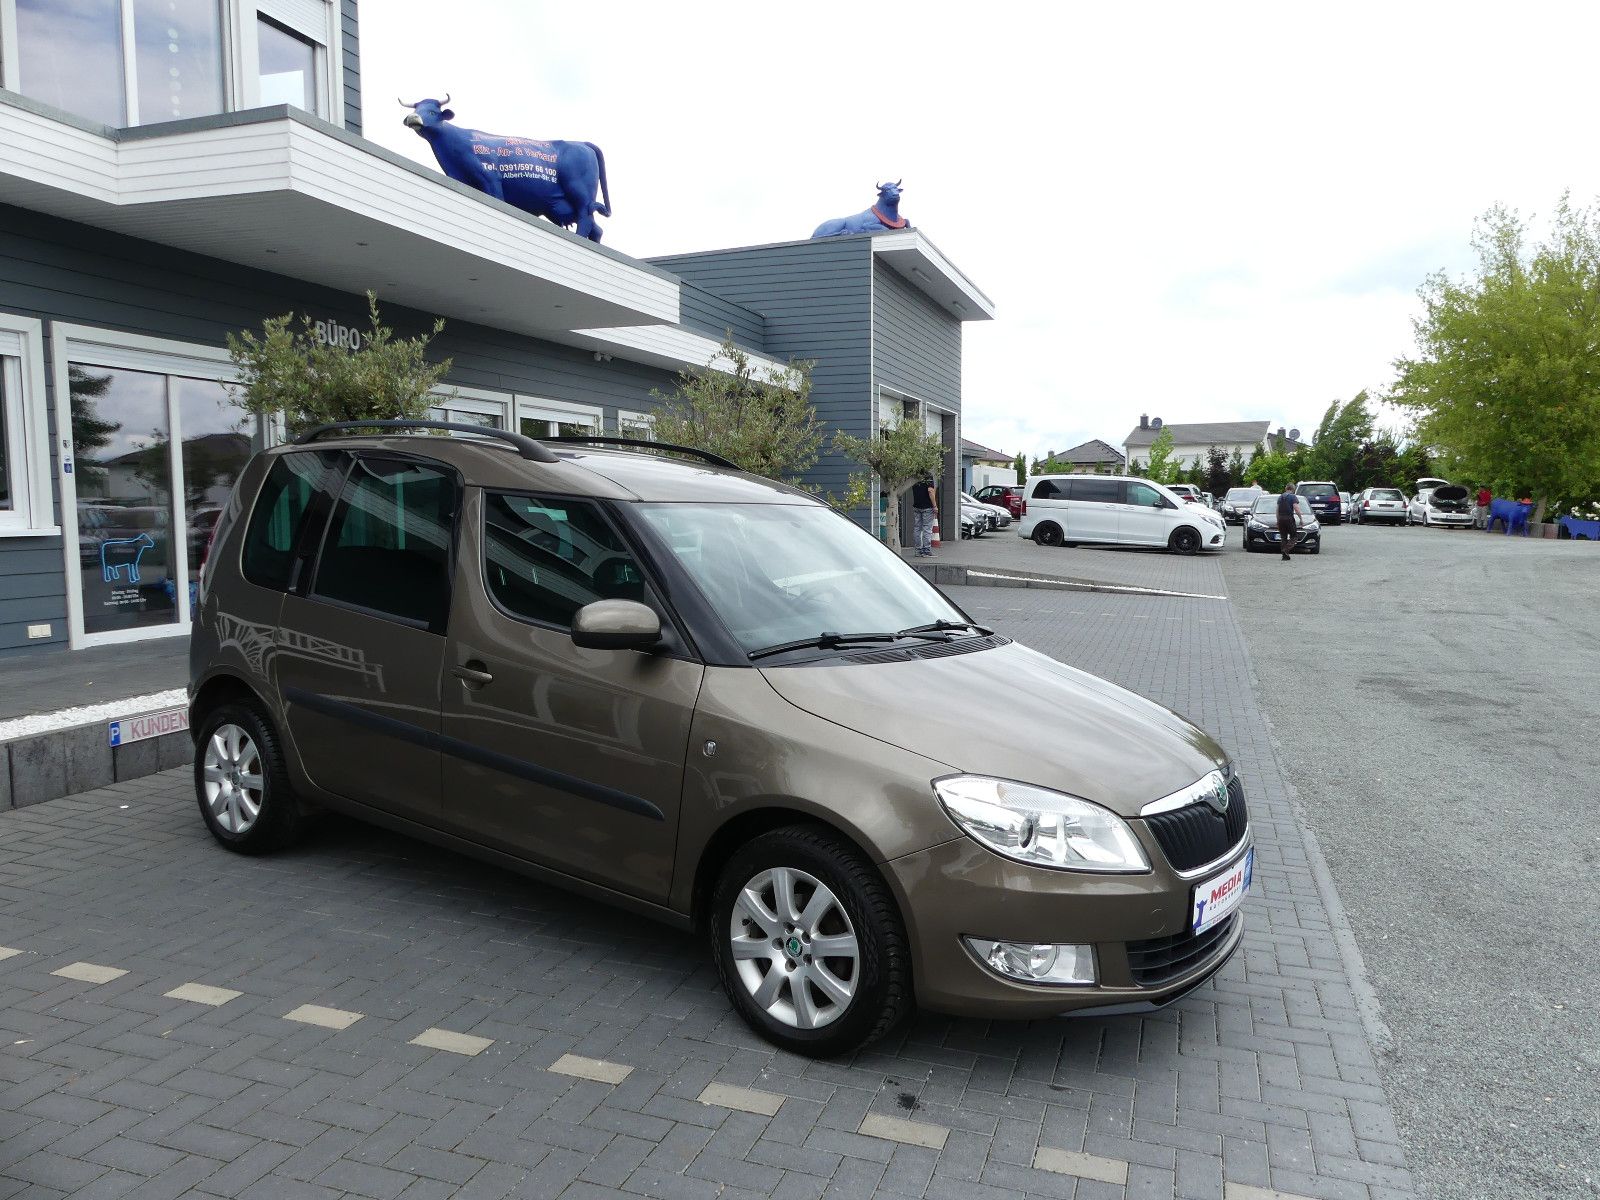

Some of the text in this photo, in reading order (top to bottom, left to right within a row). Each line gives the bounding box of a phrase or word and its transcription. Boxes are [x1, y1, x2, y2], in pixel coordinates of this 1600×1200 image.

[482, 162, 498, 171] Tel.
[499, 163, 534, 172] 0391/597
[545, 168, 557, 177] 100
[315, 319, 361, 350] BÜRO
[111, 710, 188, 742] P KUNDEN
[1210, 870, 1242, 904] MEDIA
